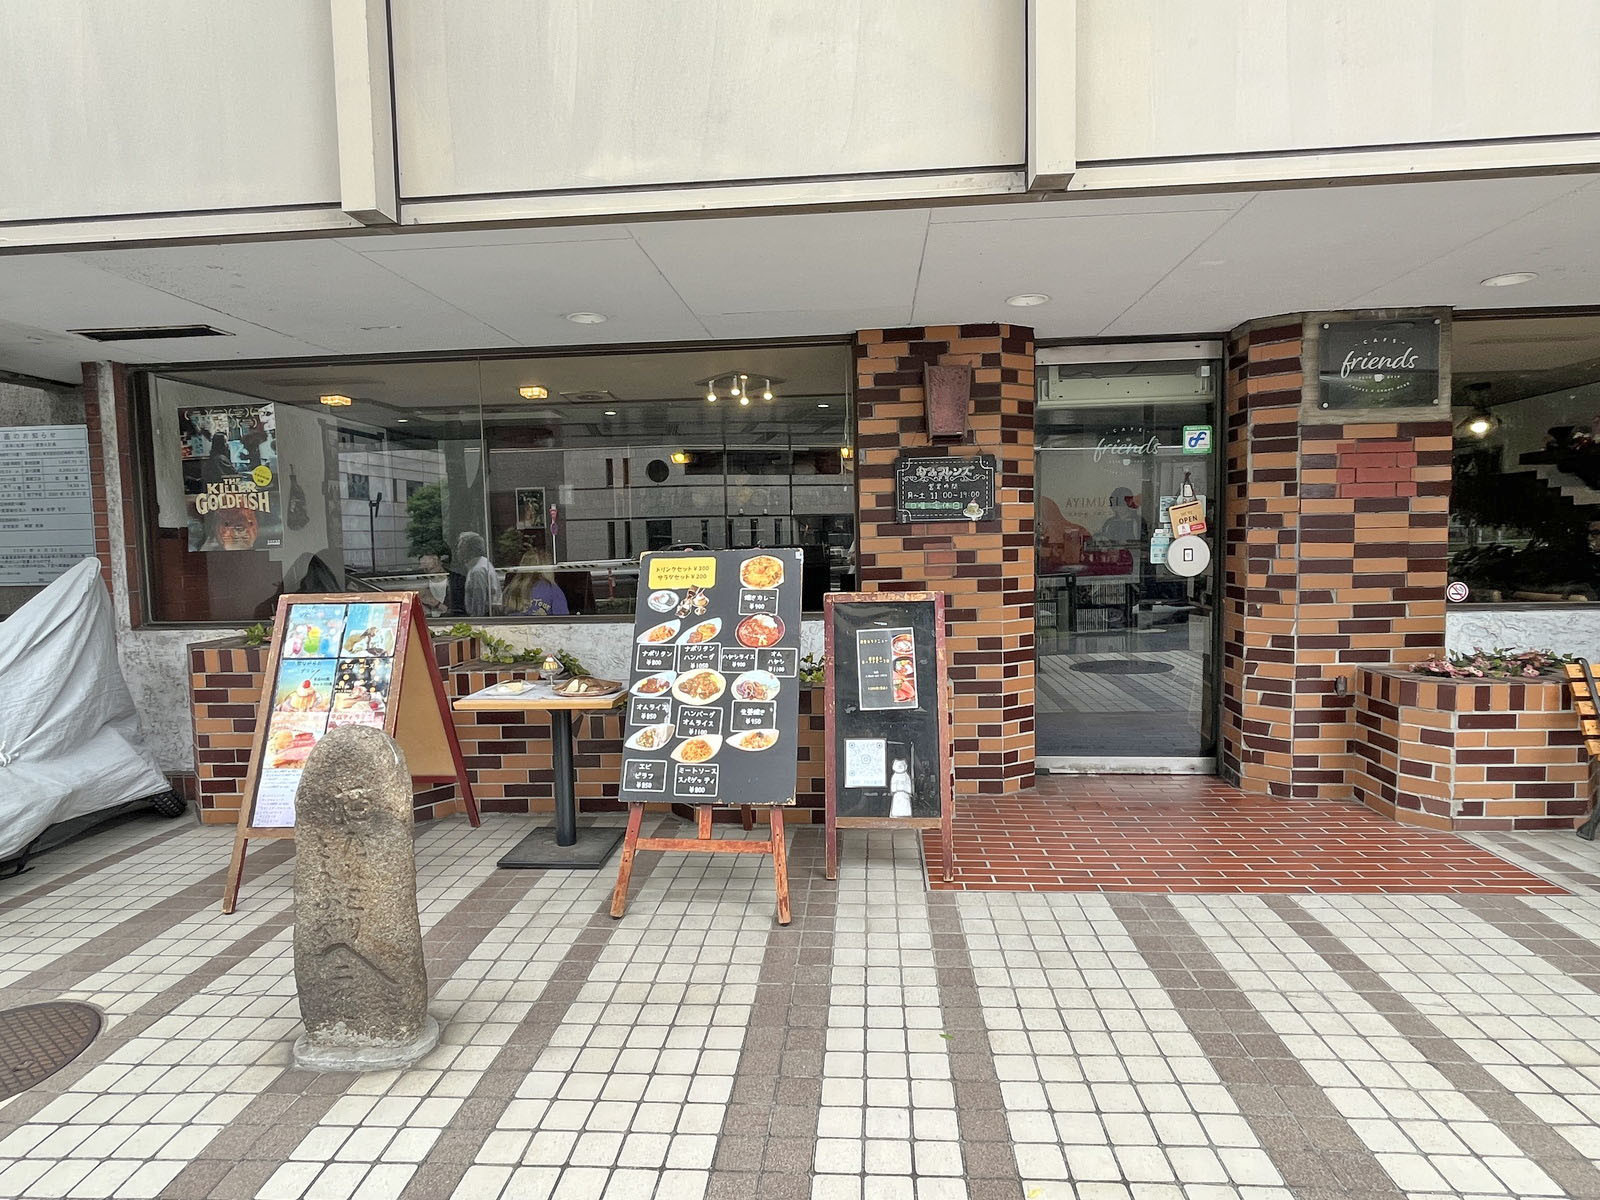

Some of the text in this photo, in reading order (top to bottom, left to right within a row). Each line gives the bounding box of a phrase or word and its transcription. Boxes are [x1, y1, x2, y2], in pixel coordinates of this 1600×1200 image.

[1362, 337, 1398, 345] CAFE
[1340, 346, 1419, 379] friends
[1093, 435, 1162, 463] friends
[206, 480, 258, 494] KILLER
[195, 491, 271, 515] GOLDFISH
[1178, 514, 1199, 525] OPEN
[743, 594, 776, 602] 焼きカレー
[684, 645, 715, 653] ナポリタン
[641, 650, 673, 658] ナポリタン
[683, 653, 716, 661] ハンバーグ
[636, 703, 668, 711] オムライス
[683, 710, 716, 718] ハンバーグ
[682, 719, 714, 727] オムライス
[678, 767, 717, 775] ミートソース
[634, 772, 654, 780] ピラフ
[677, 776, 715, 784] スパゲッティ
